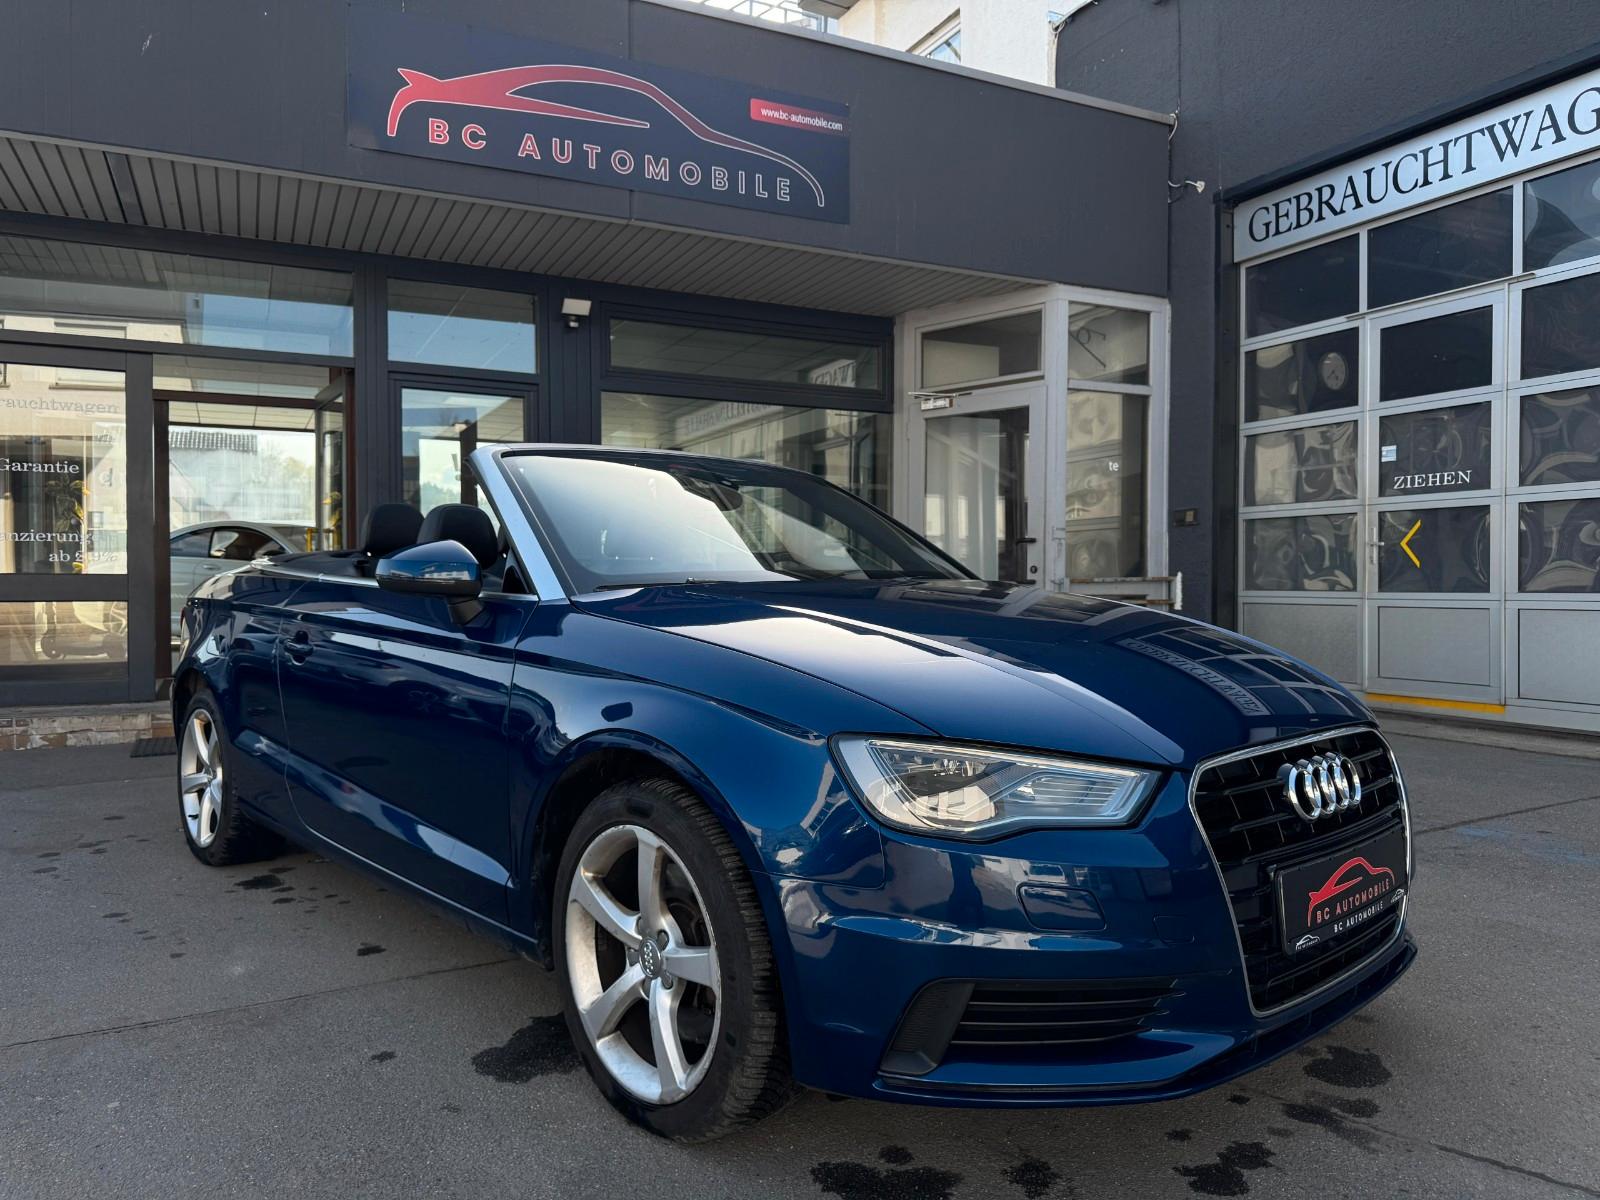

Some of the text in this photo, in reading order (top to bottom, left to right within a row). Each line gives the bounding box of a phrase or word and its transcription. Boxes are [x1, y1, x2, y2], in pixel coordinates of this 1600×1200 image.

[760, 108, 843, 131] www.bc-automobile.com
[428, 117, 791, 202] BC AUTOMOBILE
[0, 457, 79, 474] Garantie
[1393, 470, 1472, 489] ZIEHEN
[48, 550, 71, 562] ab
[1316, 907, 1330, 923] BC
[1336, 879, 1389, 914] AUTOMOBILE
[1334, 901, 1384, 933] BC AUTOMOBILE
